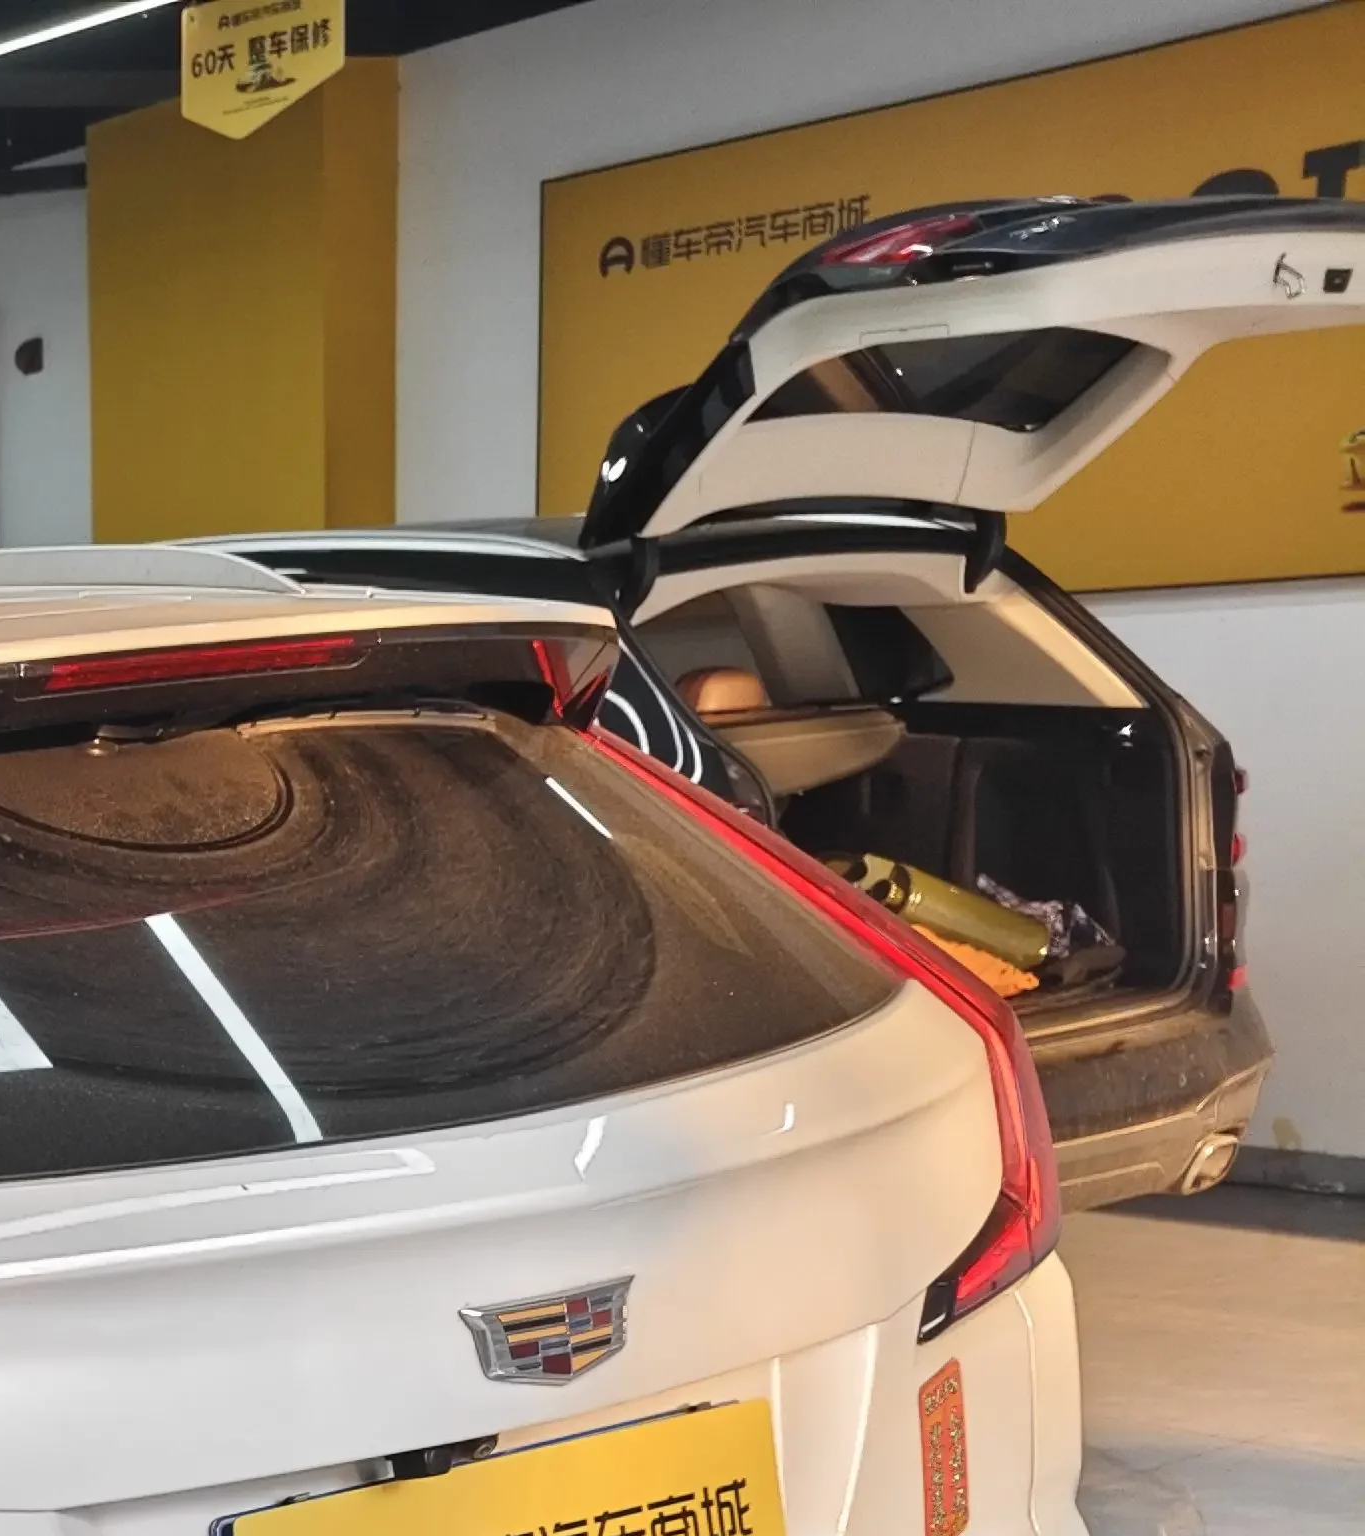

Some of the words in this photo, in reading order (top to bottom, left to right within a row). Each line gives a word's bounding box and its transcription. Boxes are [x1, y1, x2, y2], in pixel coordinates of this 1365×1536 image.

[191, 44, 236, 78] 60天
[248, 18, 331, 65] 整车保修
[641, 195, 871, 270] 懂车帝汽车商城
